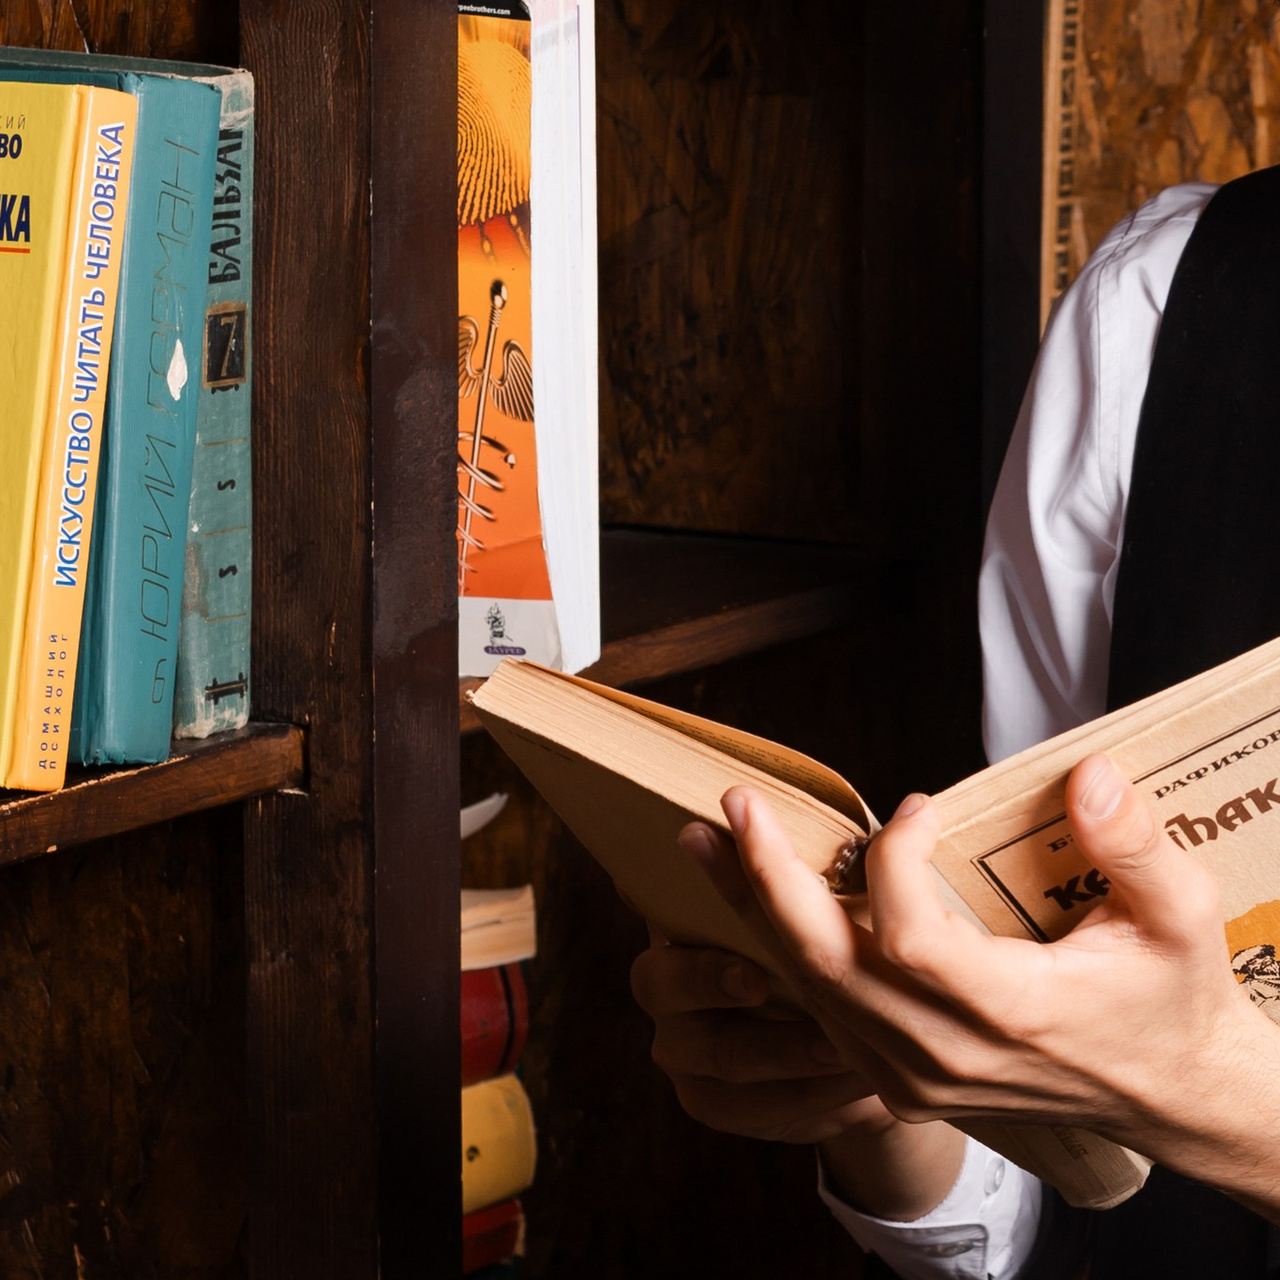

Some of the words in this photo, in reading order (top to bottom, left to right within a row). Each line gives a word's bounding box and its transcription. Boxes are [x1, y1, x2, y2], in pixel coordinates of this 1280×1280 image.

[86, 123, 125, 280] ЧЕЛОВЕКА
[73, 287, 106, 402] ЧИТАТЬ
[55, 411, 93, 587] ИСКУССТВО
[139, 433, 177, 642] ЮРИЙ
[39, 634, 58, 770] ДОМАШНИЙ
[49, 634, 68, 770] ПСИХОЛОГ
